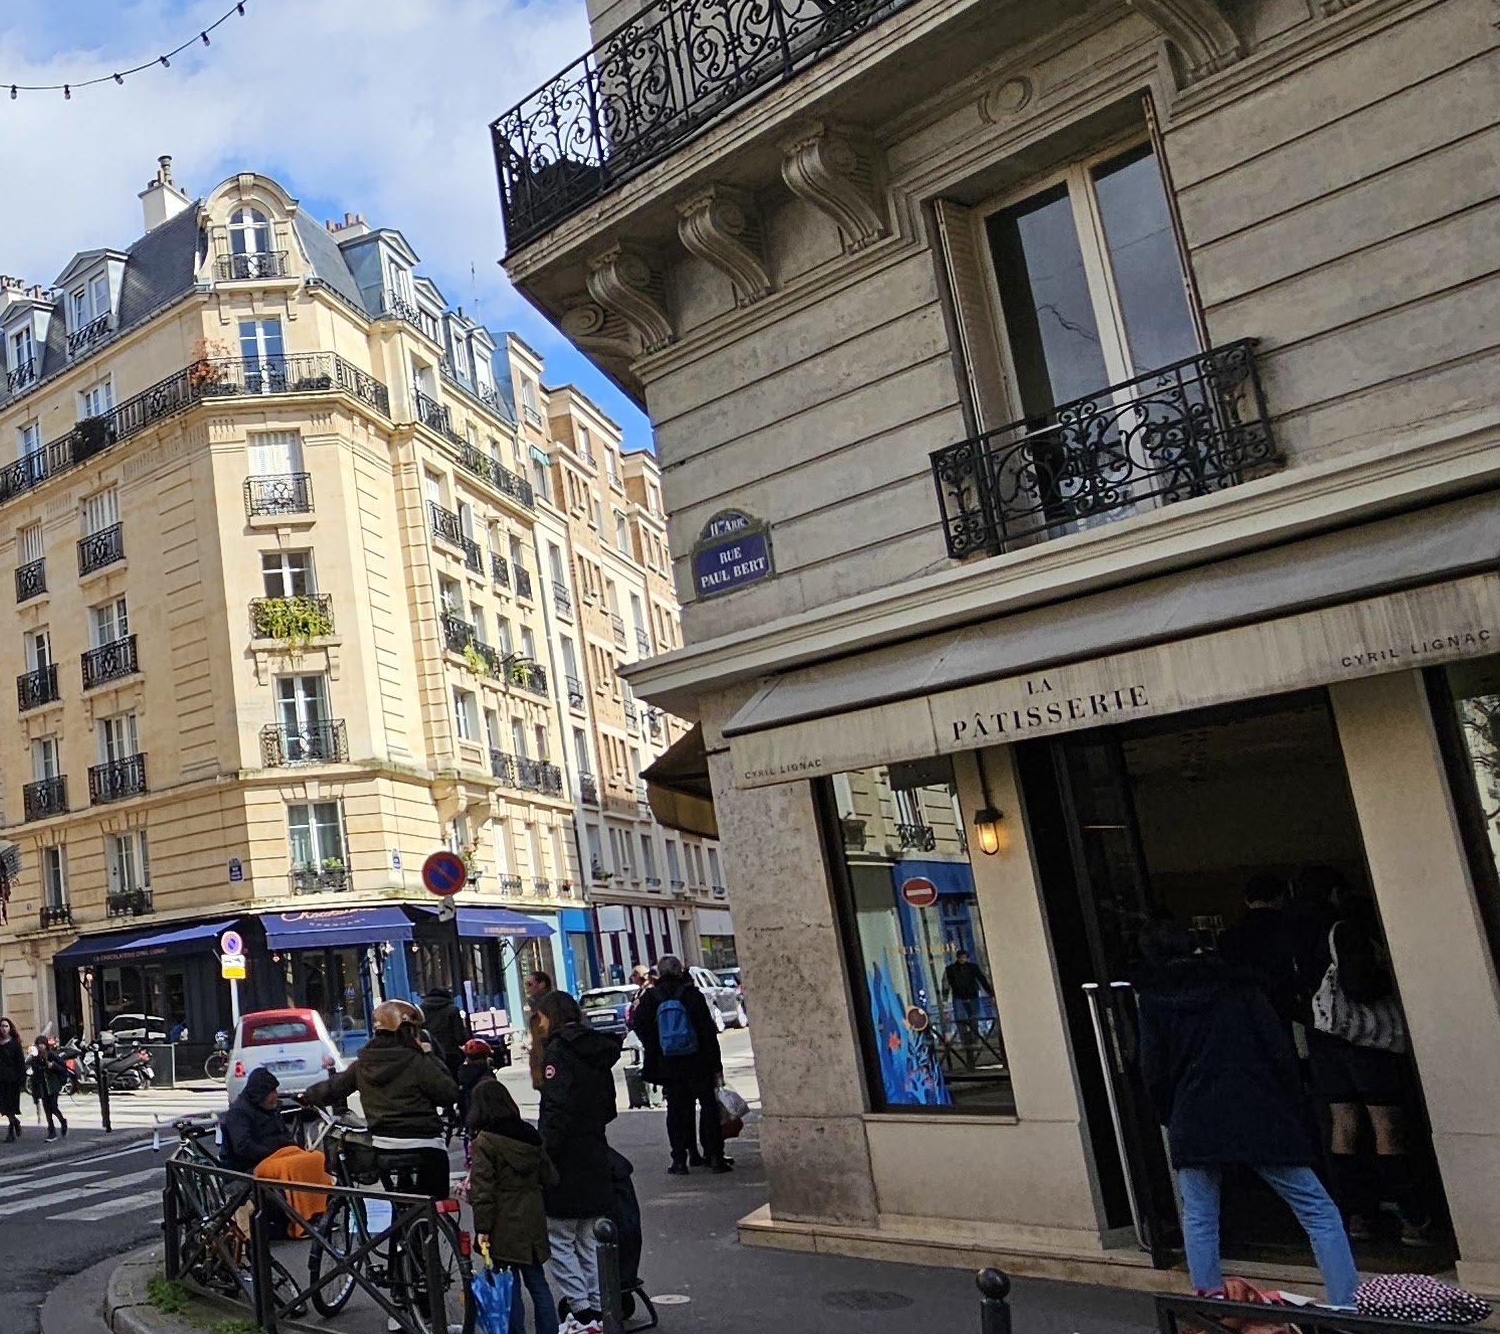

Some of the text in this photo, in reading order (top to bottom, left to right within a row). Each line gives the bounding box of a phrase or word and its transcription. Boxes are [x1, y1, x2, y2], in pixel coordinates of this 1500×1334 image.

[719, 547, 742, 564] RUE
[701, 556, 765, 588] PAUL BERT
[1341, 629, 1491, 667] CYRIL LIGNAC
[1027, 678, 1053, 695] LA
[952, 685, 1149, 741] PÂTISSERIE
[744, 759, 822, 780] CYRIL LIGNAC
